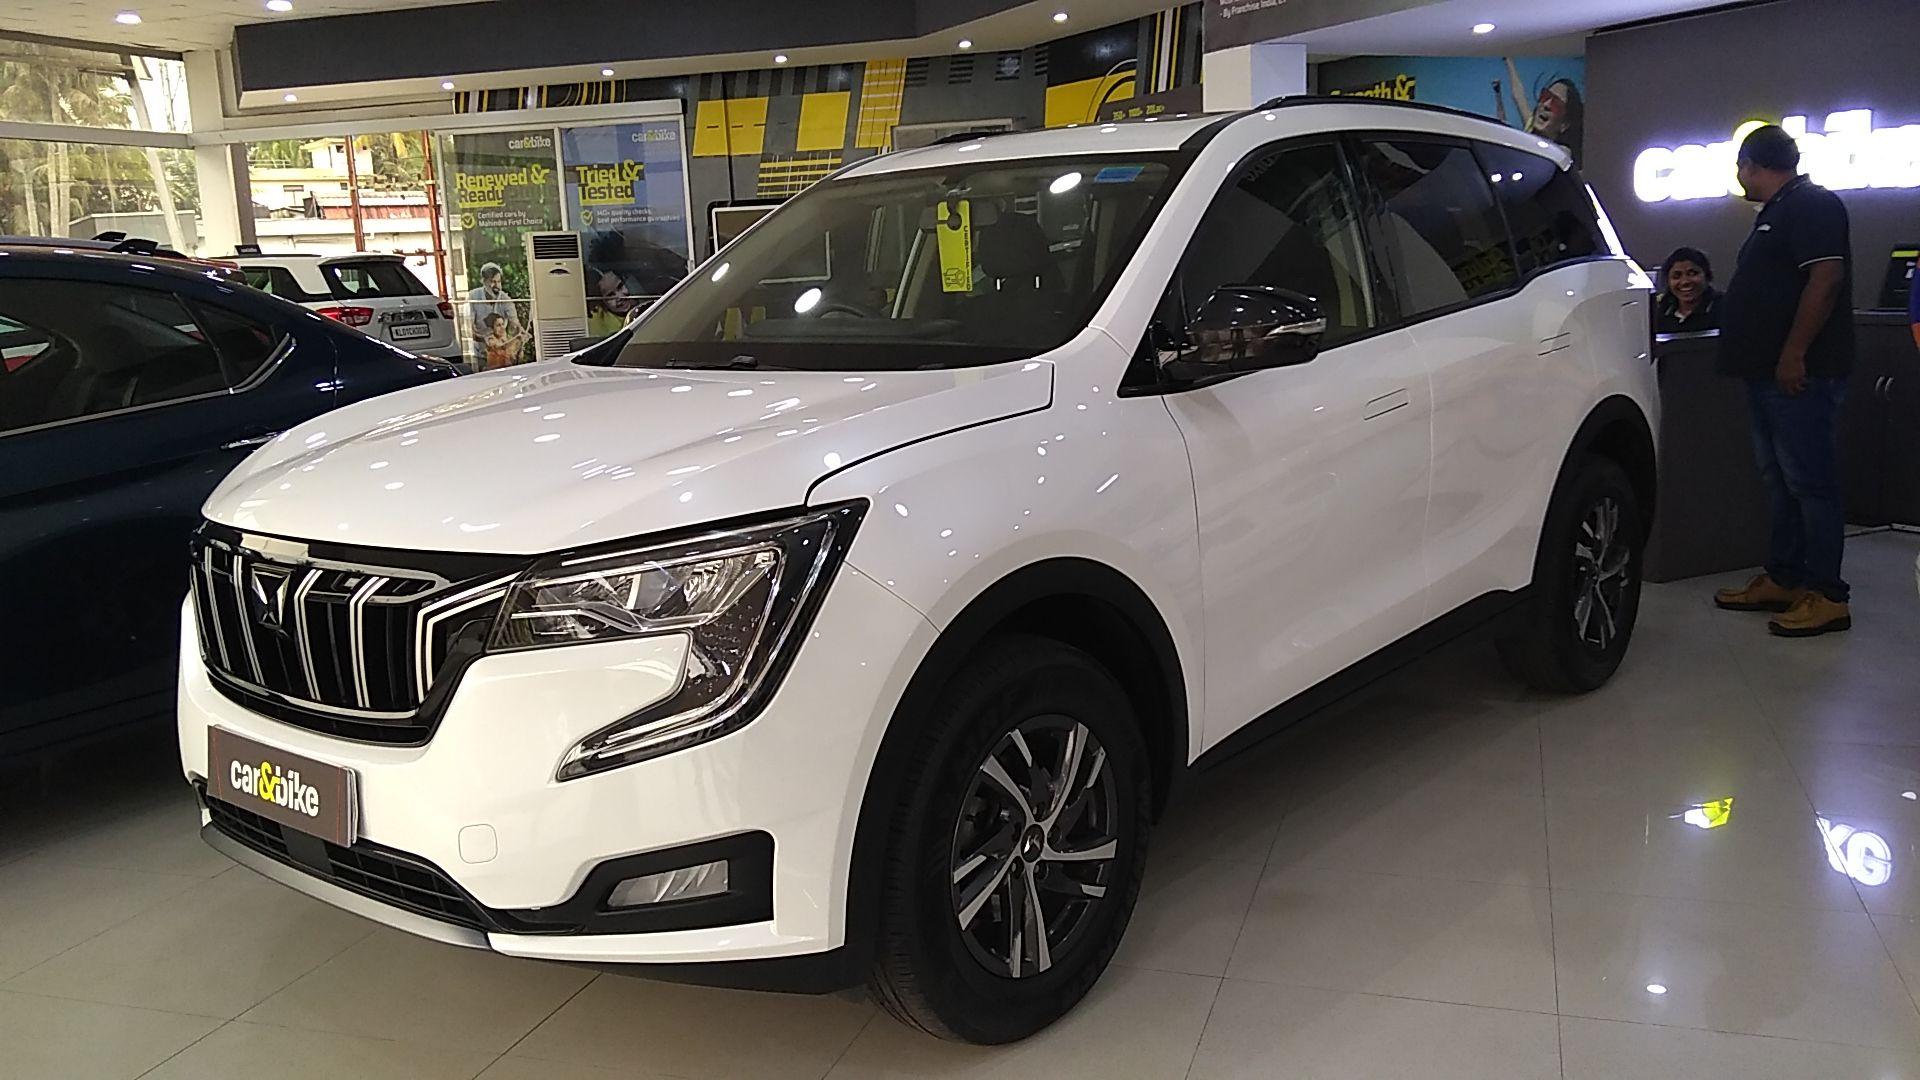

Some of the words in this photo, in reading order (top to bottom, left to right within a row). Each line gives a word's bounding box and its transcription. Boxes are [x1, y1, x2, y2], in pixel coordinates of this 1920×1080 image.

[508, 136, 551, 150] car&bike
[631, 129, 676, 143] car&bike
[455, 167, 528, 189] Renewed
[530, 163, 550, 185] &
[575, 163, 620, 184] Tried
[622, 159, 644, 181] &
[458, 187, 505, 206] Ready
[578, 182, 635, 200] Tested
[477, 211, 503, 219] Certified
[517, 210, 526, 218] by
[479, 219, 507, 227] Mahindra
[523, 217, 543, 225] Choice
[610, 215, 647, 224] performance
[230, 760, 319, 817] car&bike
